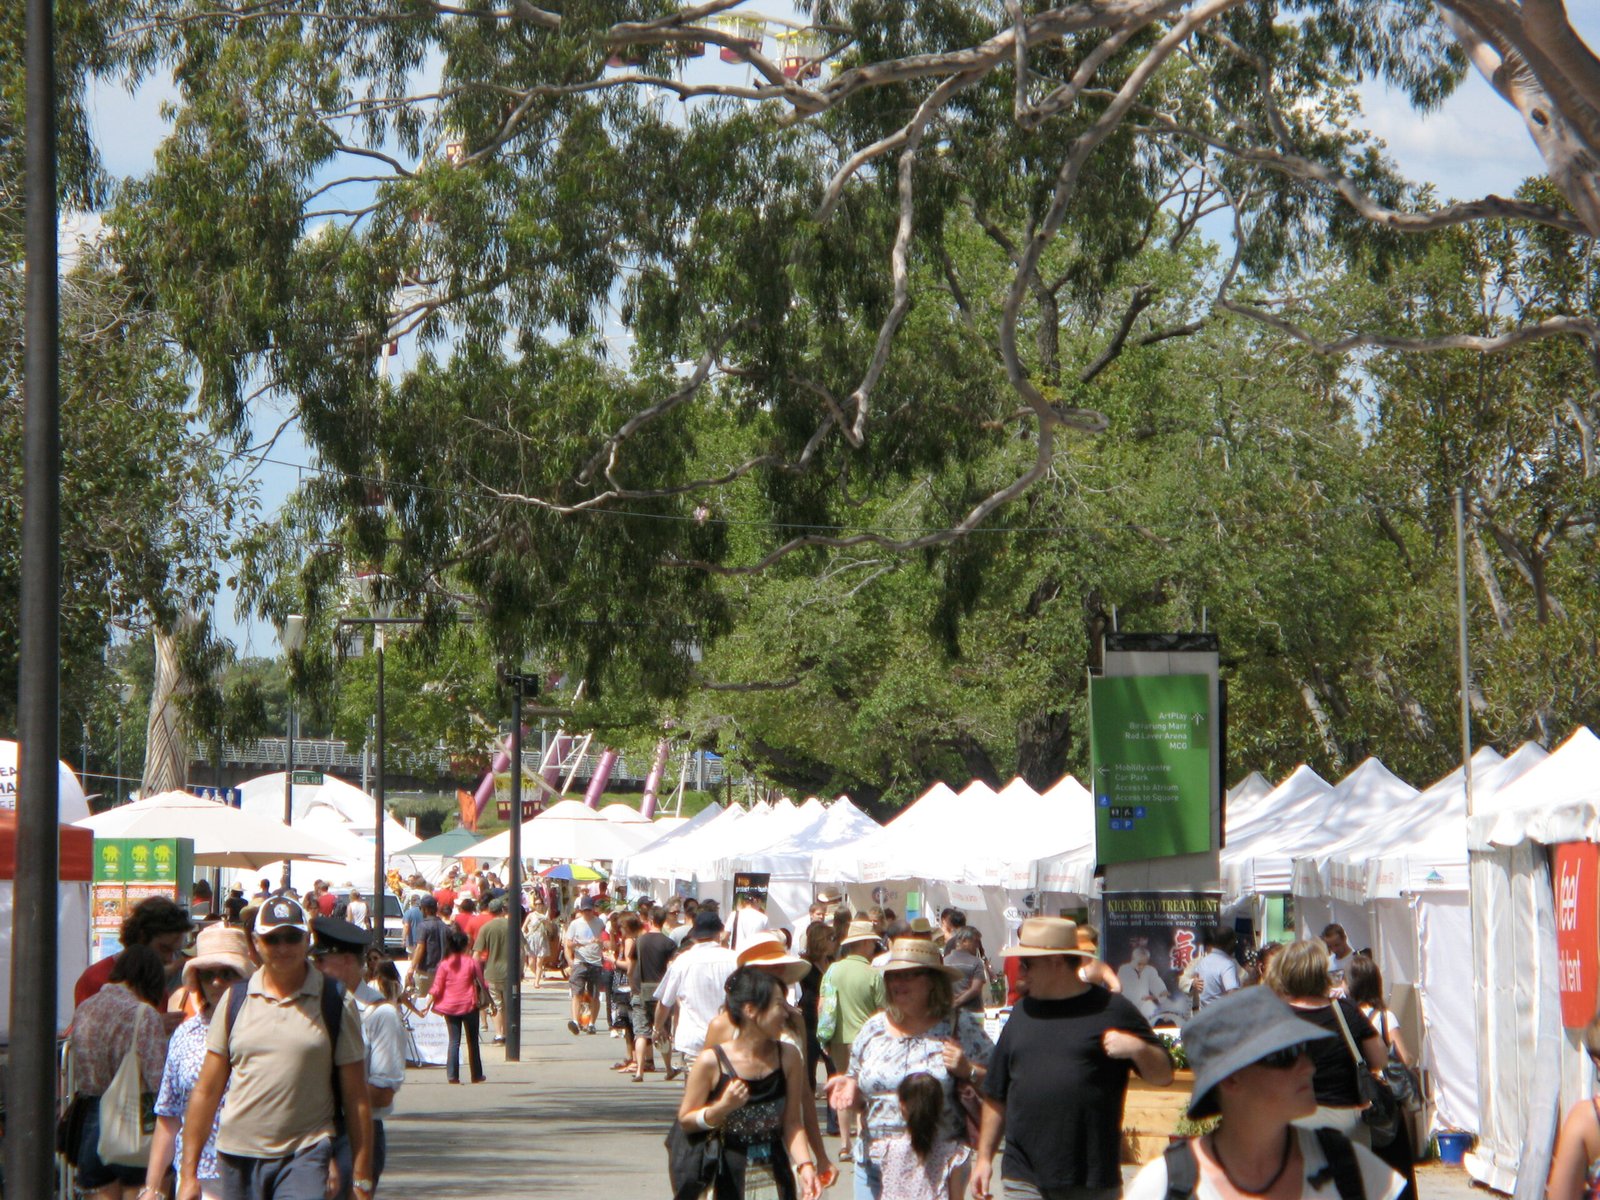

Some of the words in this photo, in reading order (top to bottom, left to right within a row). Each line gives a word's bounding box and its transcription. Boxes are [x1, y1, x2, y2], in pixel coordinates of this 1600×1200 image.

[1158, 711, 1188, 721] ArtPlay
[1168, 722, 1187, 731] Marr
[1164, 731, 1188, 740] Arena
[1169, 741, 1188, 750] MCG
[1129, 773, 1149, 782] Park
